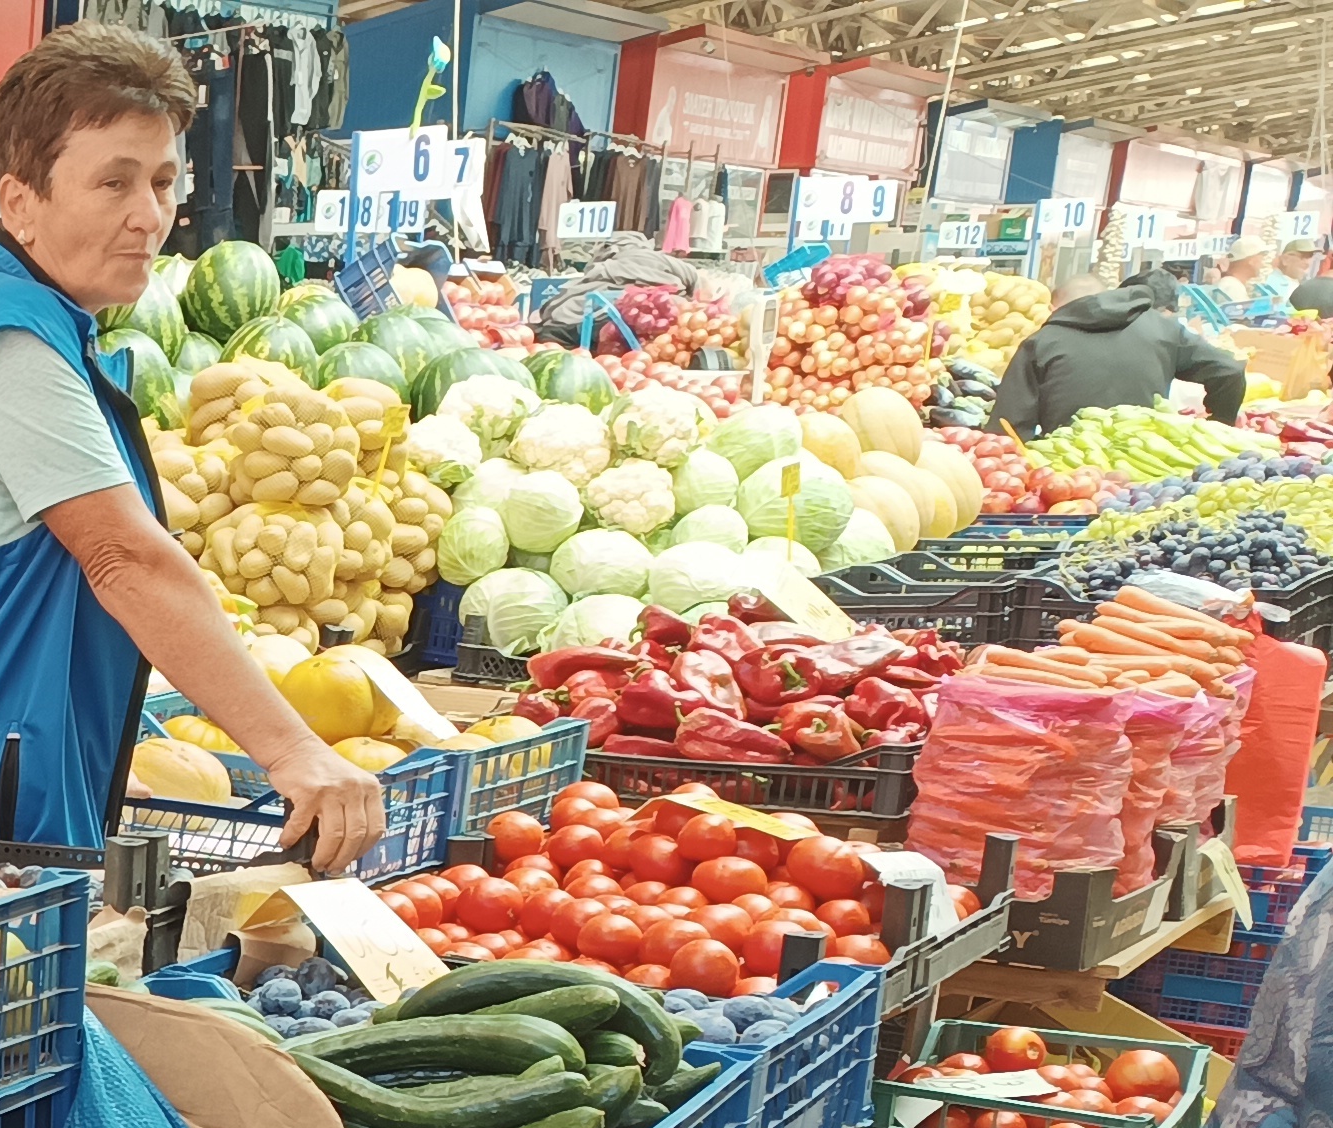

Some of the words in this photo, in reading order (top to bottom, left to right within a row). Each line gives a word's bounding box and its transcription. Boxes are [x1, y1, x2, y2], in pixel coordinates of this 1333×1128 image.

[413, 134, 431, 181] 6
[454, 146, 470, 183] 7
[840, 180, 855, 214] 8
[872, 186, 886, 217] 9
[579, 206, 609, 233] 110
[1064, 201, 1084, 227] 10
[1137, 213, 1156, 239] 11
[1293, 214, 1312, 236] 12
[955, 225, 981, 246] 112
